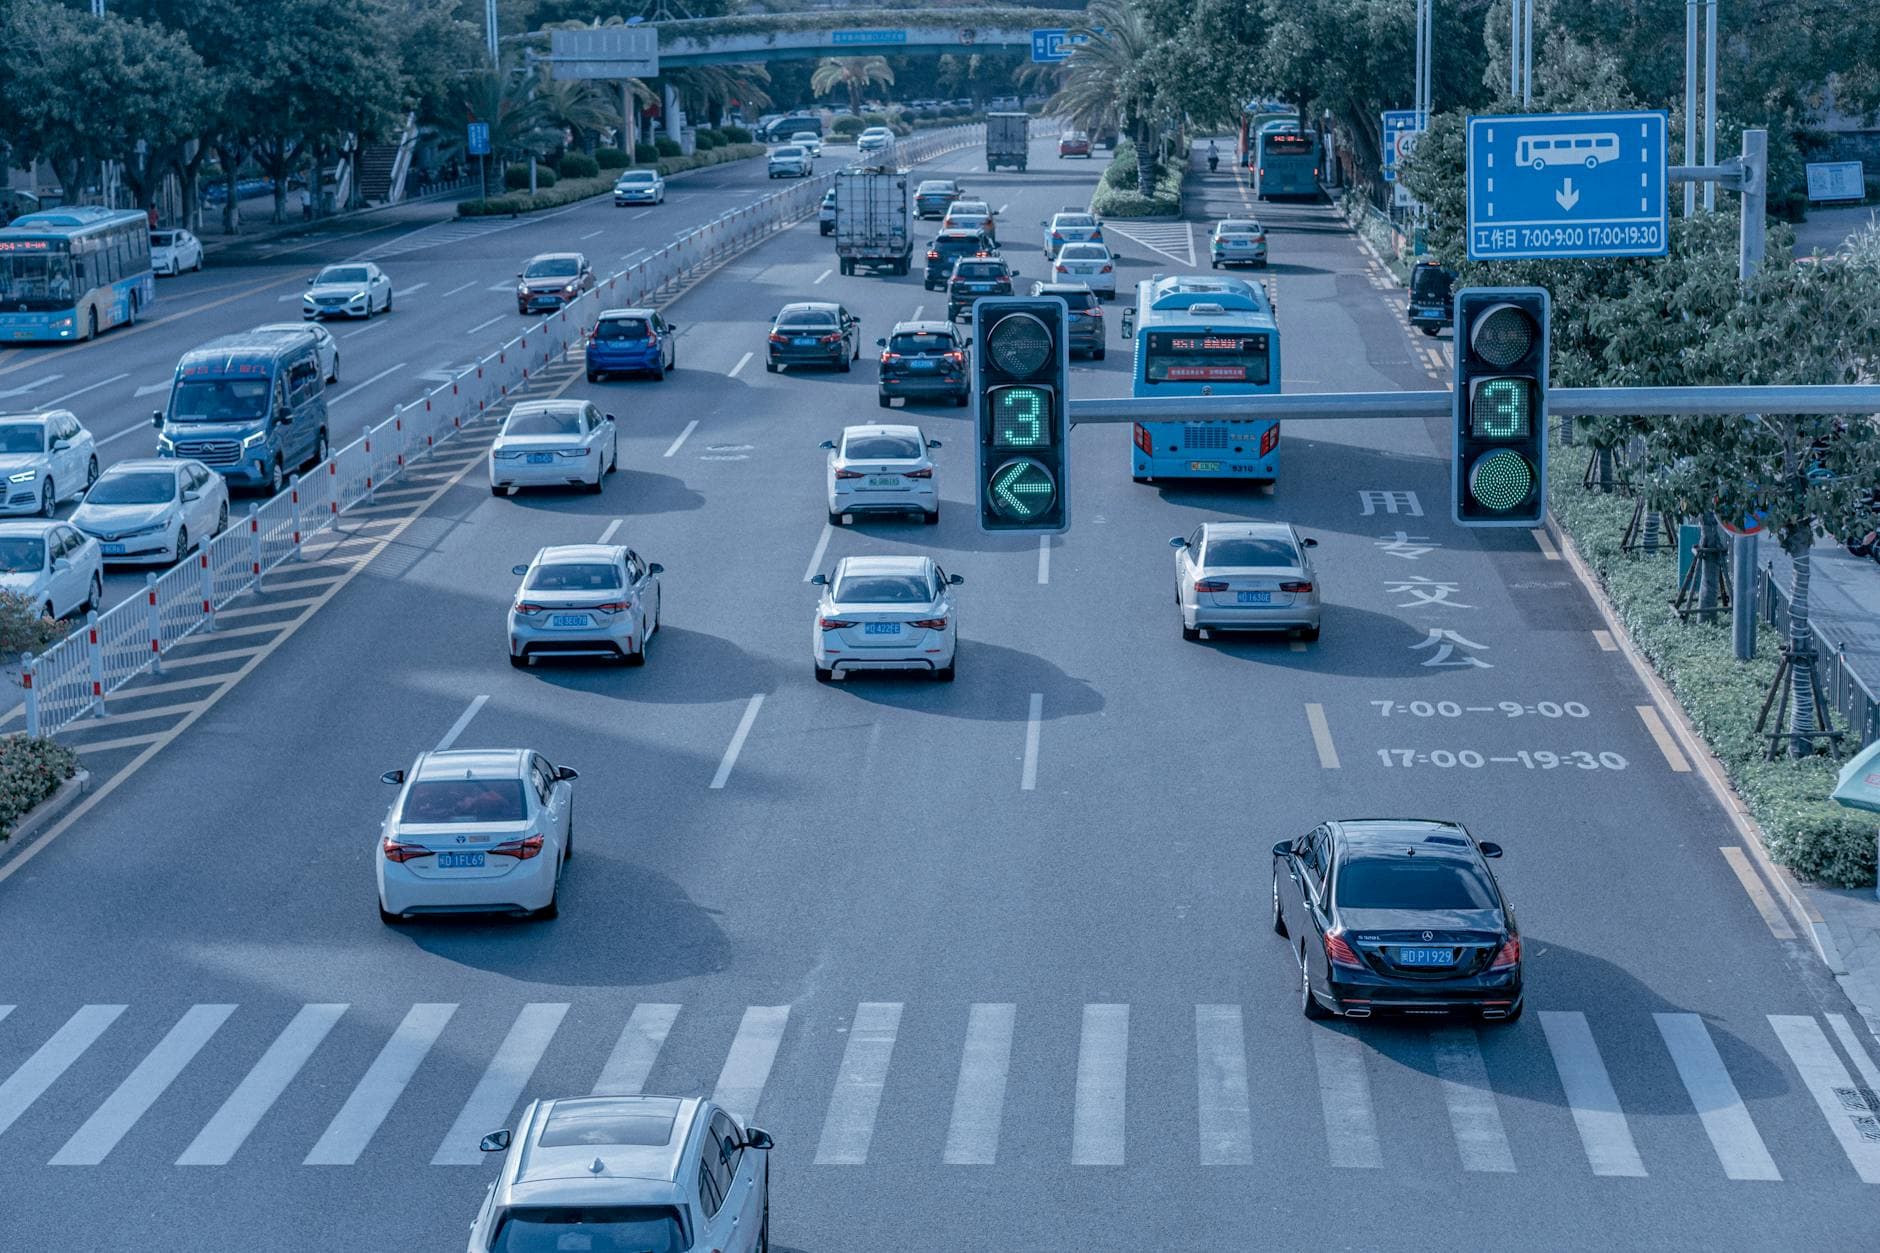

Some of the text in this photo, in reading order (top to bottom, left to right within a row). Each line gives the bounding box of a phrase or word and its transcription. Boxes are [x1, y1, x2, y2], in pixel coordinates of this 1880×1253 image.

[1477, 226, 1657, 249] 工作日 7:00-9:00 17:00-19:30
[1005, 391, 1039, 445] 3
[1485, 381, 1518, 436] 3
